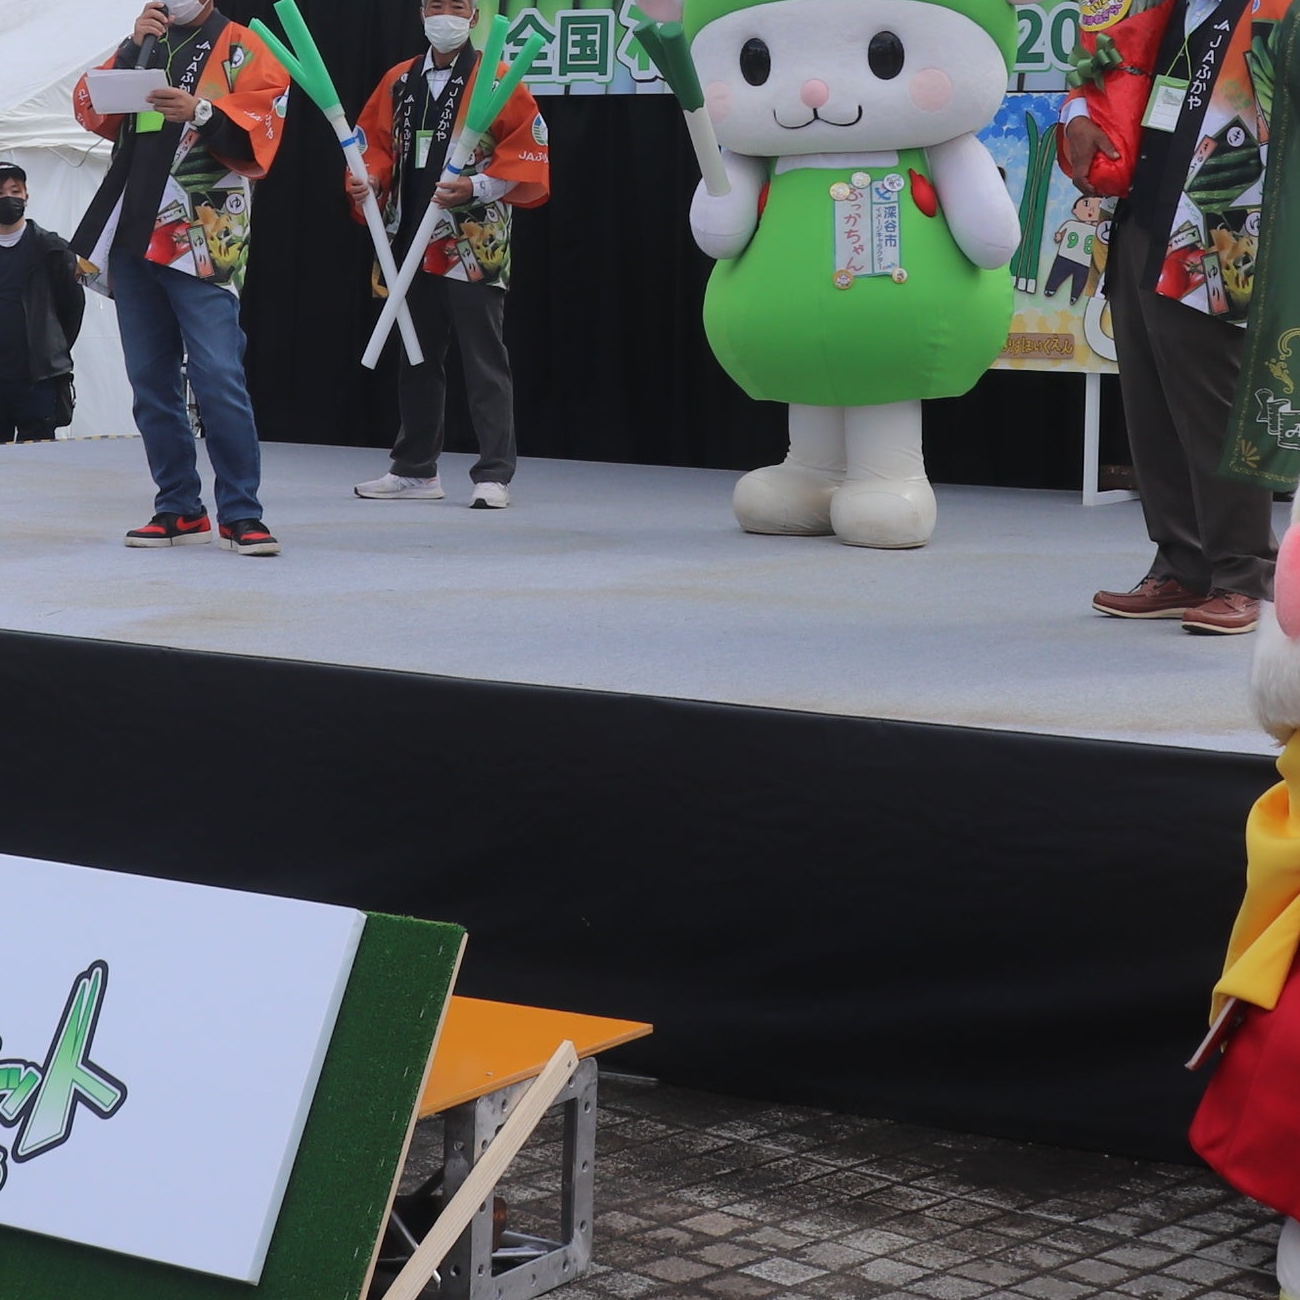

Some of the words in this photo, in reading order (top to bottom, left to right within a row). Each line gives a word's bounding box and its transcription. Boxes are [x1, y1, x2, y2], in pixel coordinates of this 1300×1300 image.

[503, 13, 610, 76] 全国
[1187, 34, 1223, 110] JAふかや
